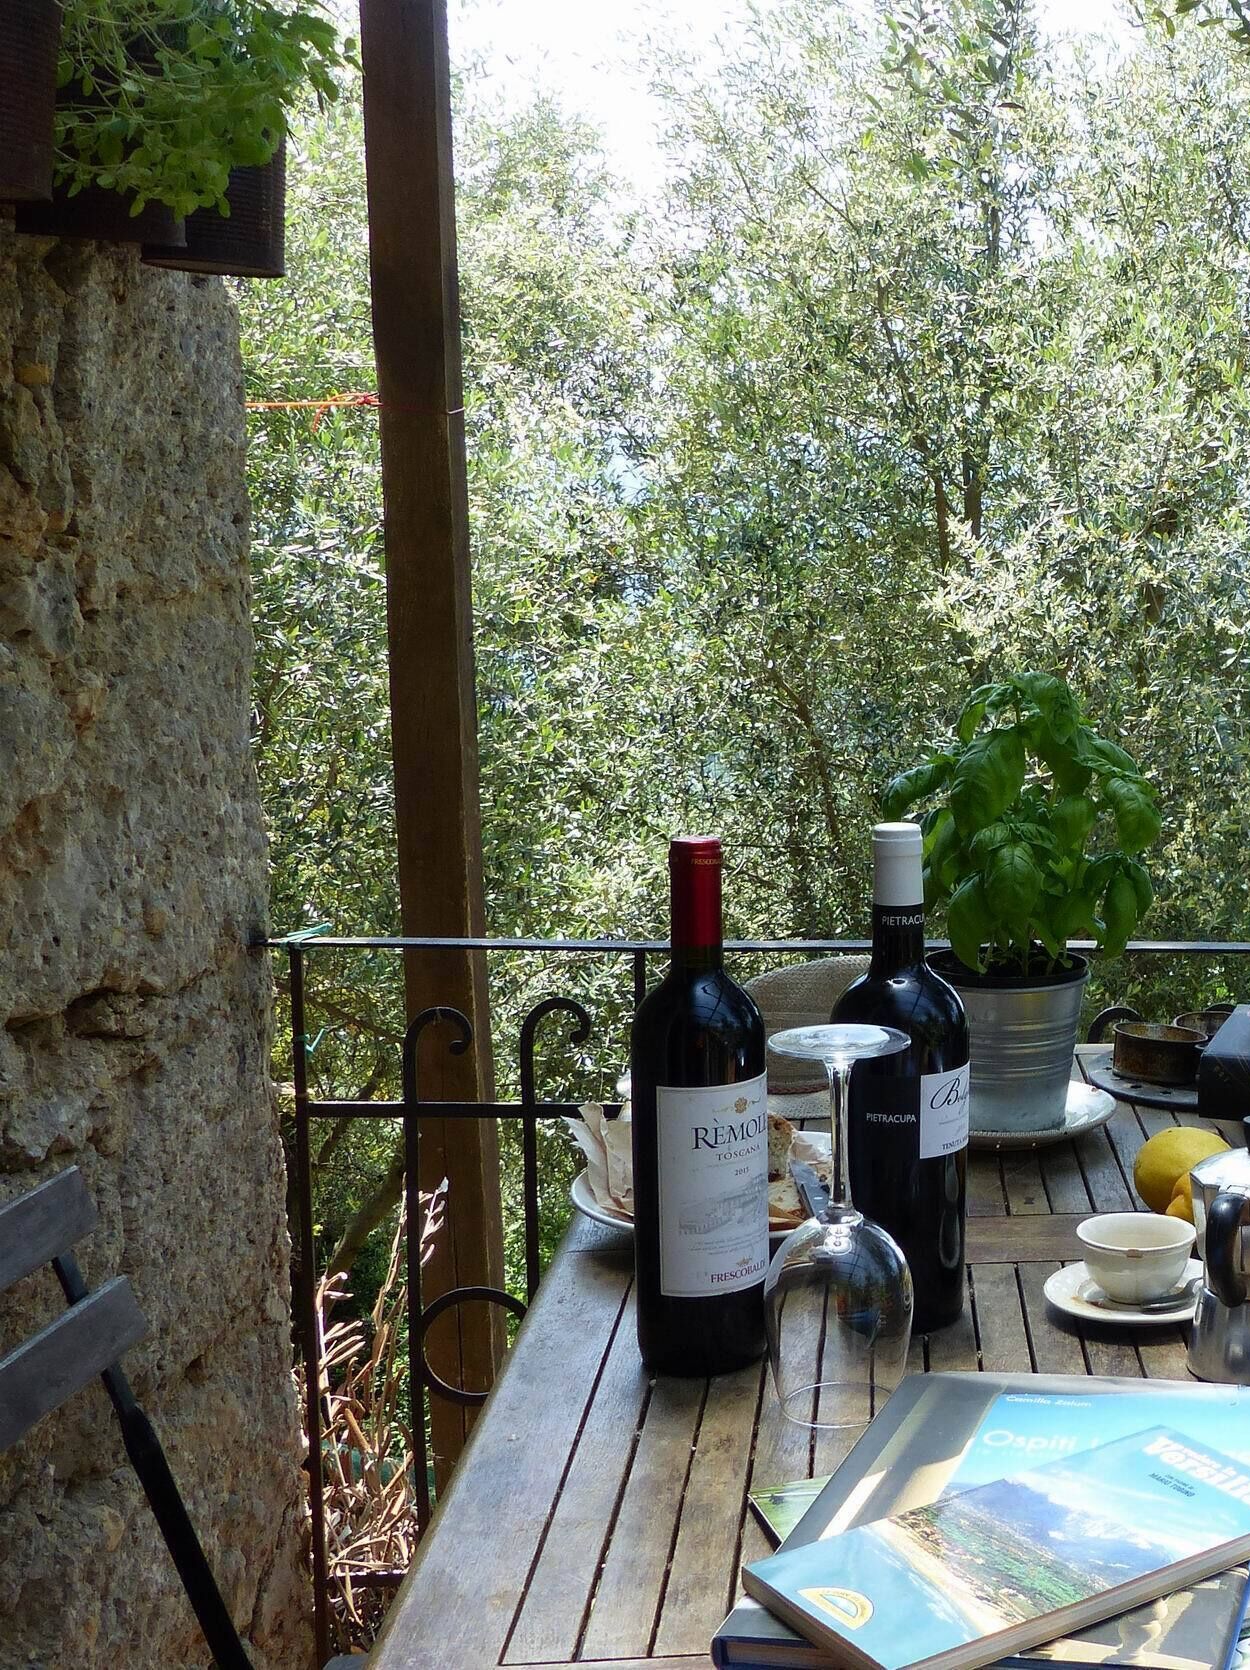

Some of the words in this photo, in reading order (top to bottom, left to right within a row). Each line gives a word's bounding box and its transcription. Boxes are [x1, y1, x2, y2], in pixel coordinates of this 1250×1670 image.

[866, 1112, 917, 1124] PIETRACUPA
[716, 1144, 761, 1161] TOSCANA
[983, 1429, 1078, 1452] Ospiti
